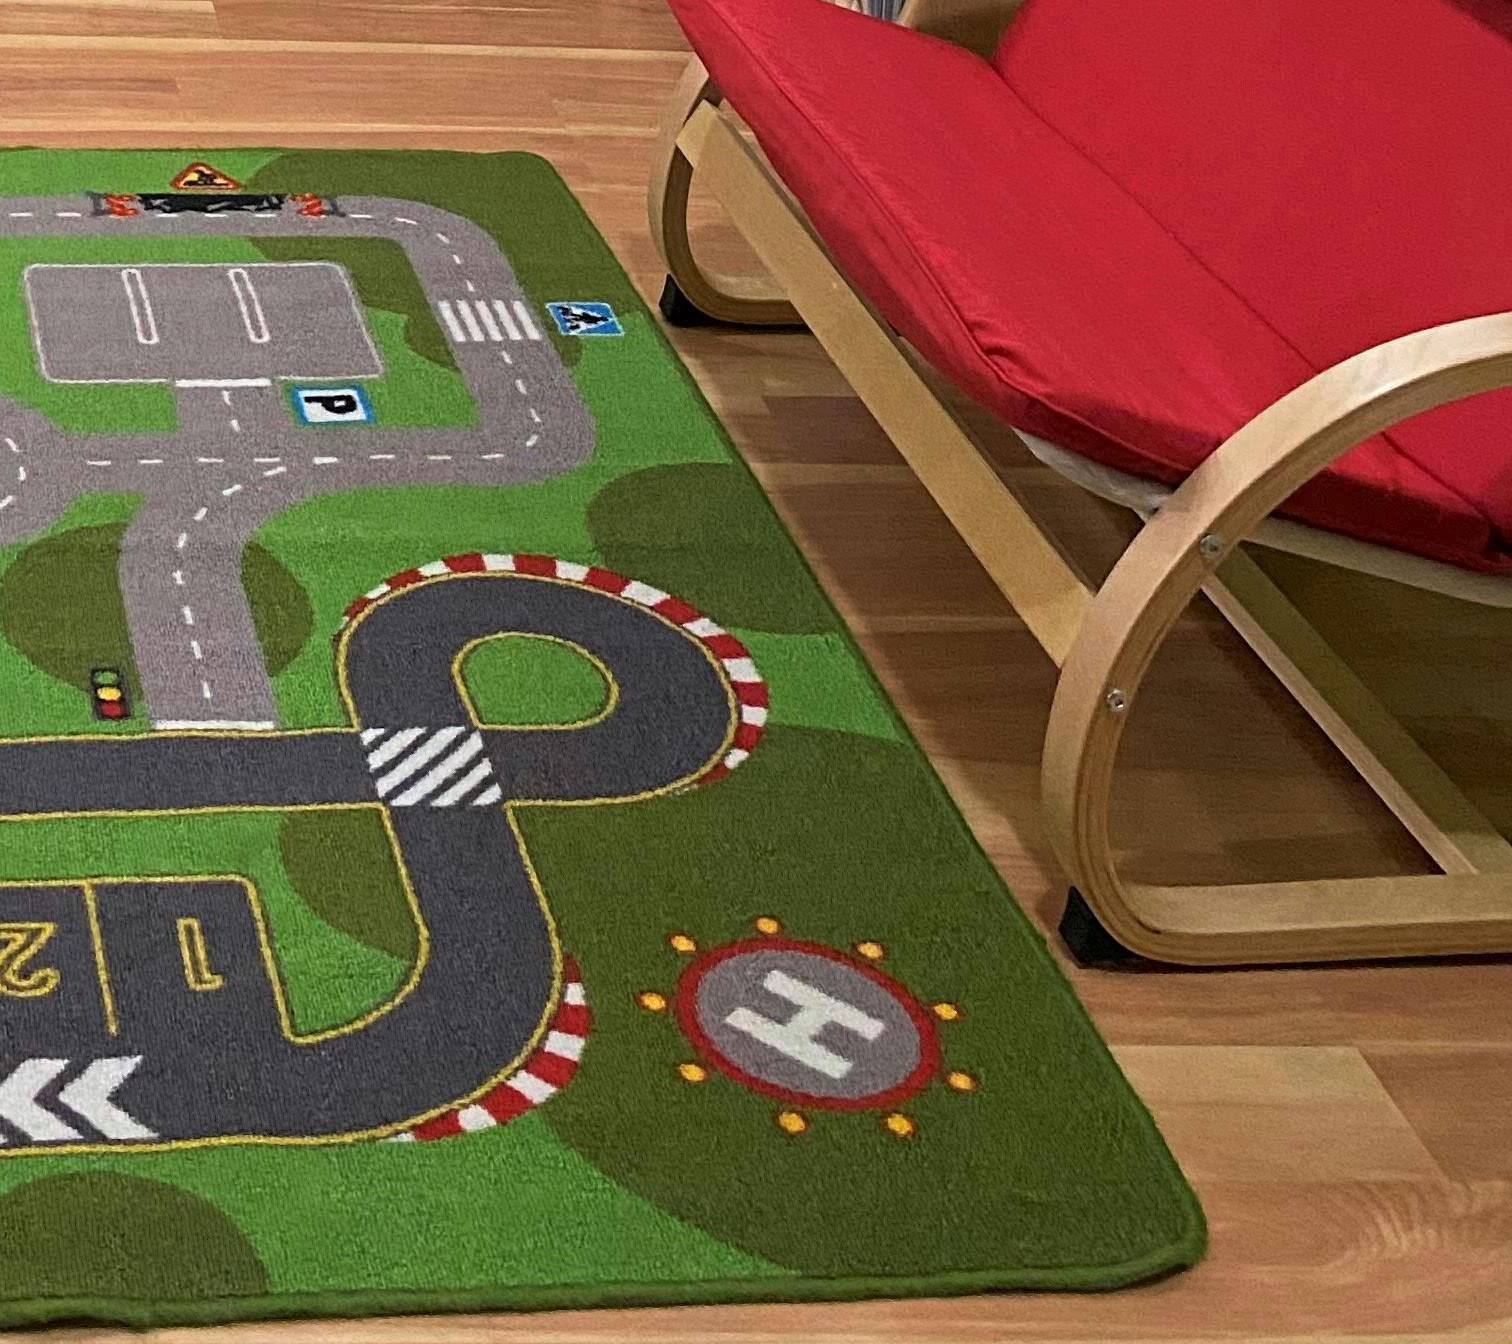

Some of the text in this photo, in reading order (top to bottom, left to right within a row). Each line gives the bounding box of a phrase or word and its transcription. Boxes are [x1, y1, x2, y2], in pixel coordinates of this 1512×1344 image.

[304, 395, 357, 414] P
[176, 918, 223, 992] 1
[725, 970, 886, 1079] H
